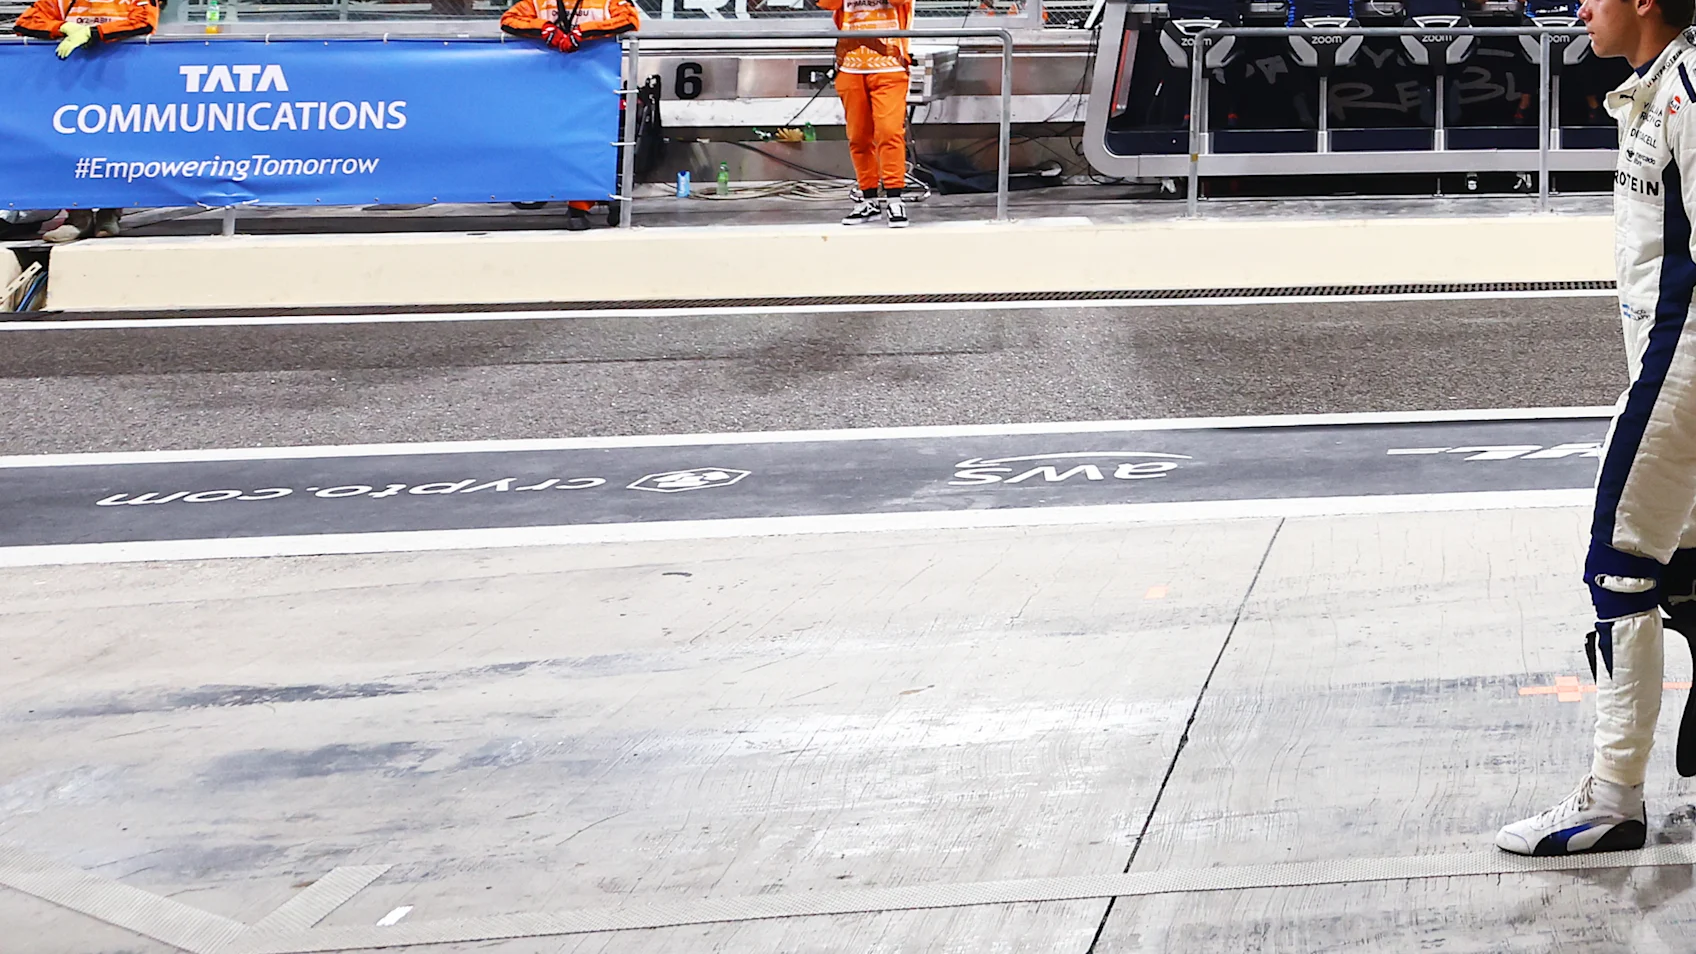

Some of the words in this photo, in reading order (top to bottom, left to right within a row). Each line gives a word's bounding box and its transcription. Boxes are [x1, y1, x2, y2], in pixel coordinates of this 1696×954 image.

[1181, 36, 1212, 47] zom
[1311, 35, 1342, 45] zoom
[1548, 34, 1570, 43] oom
[178, 64, 289, 93] TATA
[674, 61, 703, 100] 6
[52, 99, 407, 136] COMMUNICATIONS
[74, 153, 379, 183] #EmpoweringTomorrow
[947, 460, 1179, 485] aws
[96, 476, 607, 507] crypto.com
